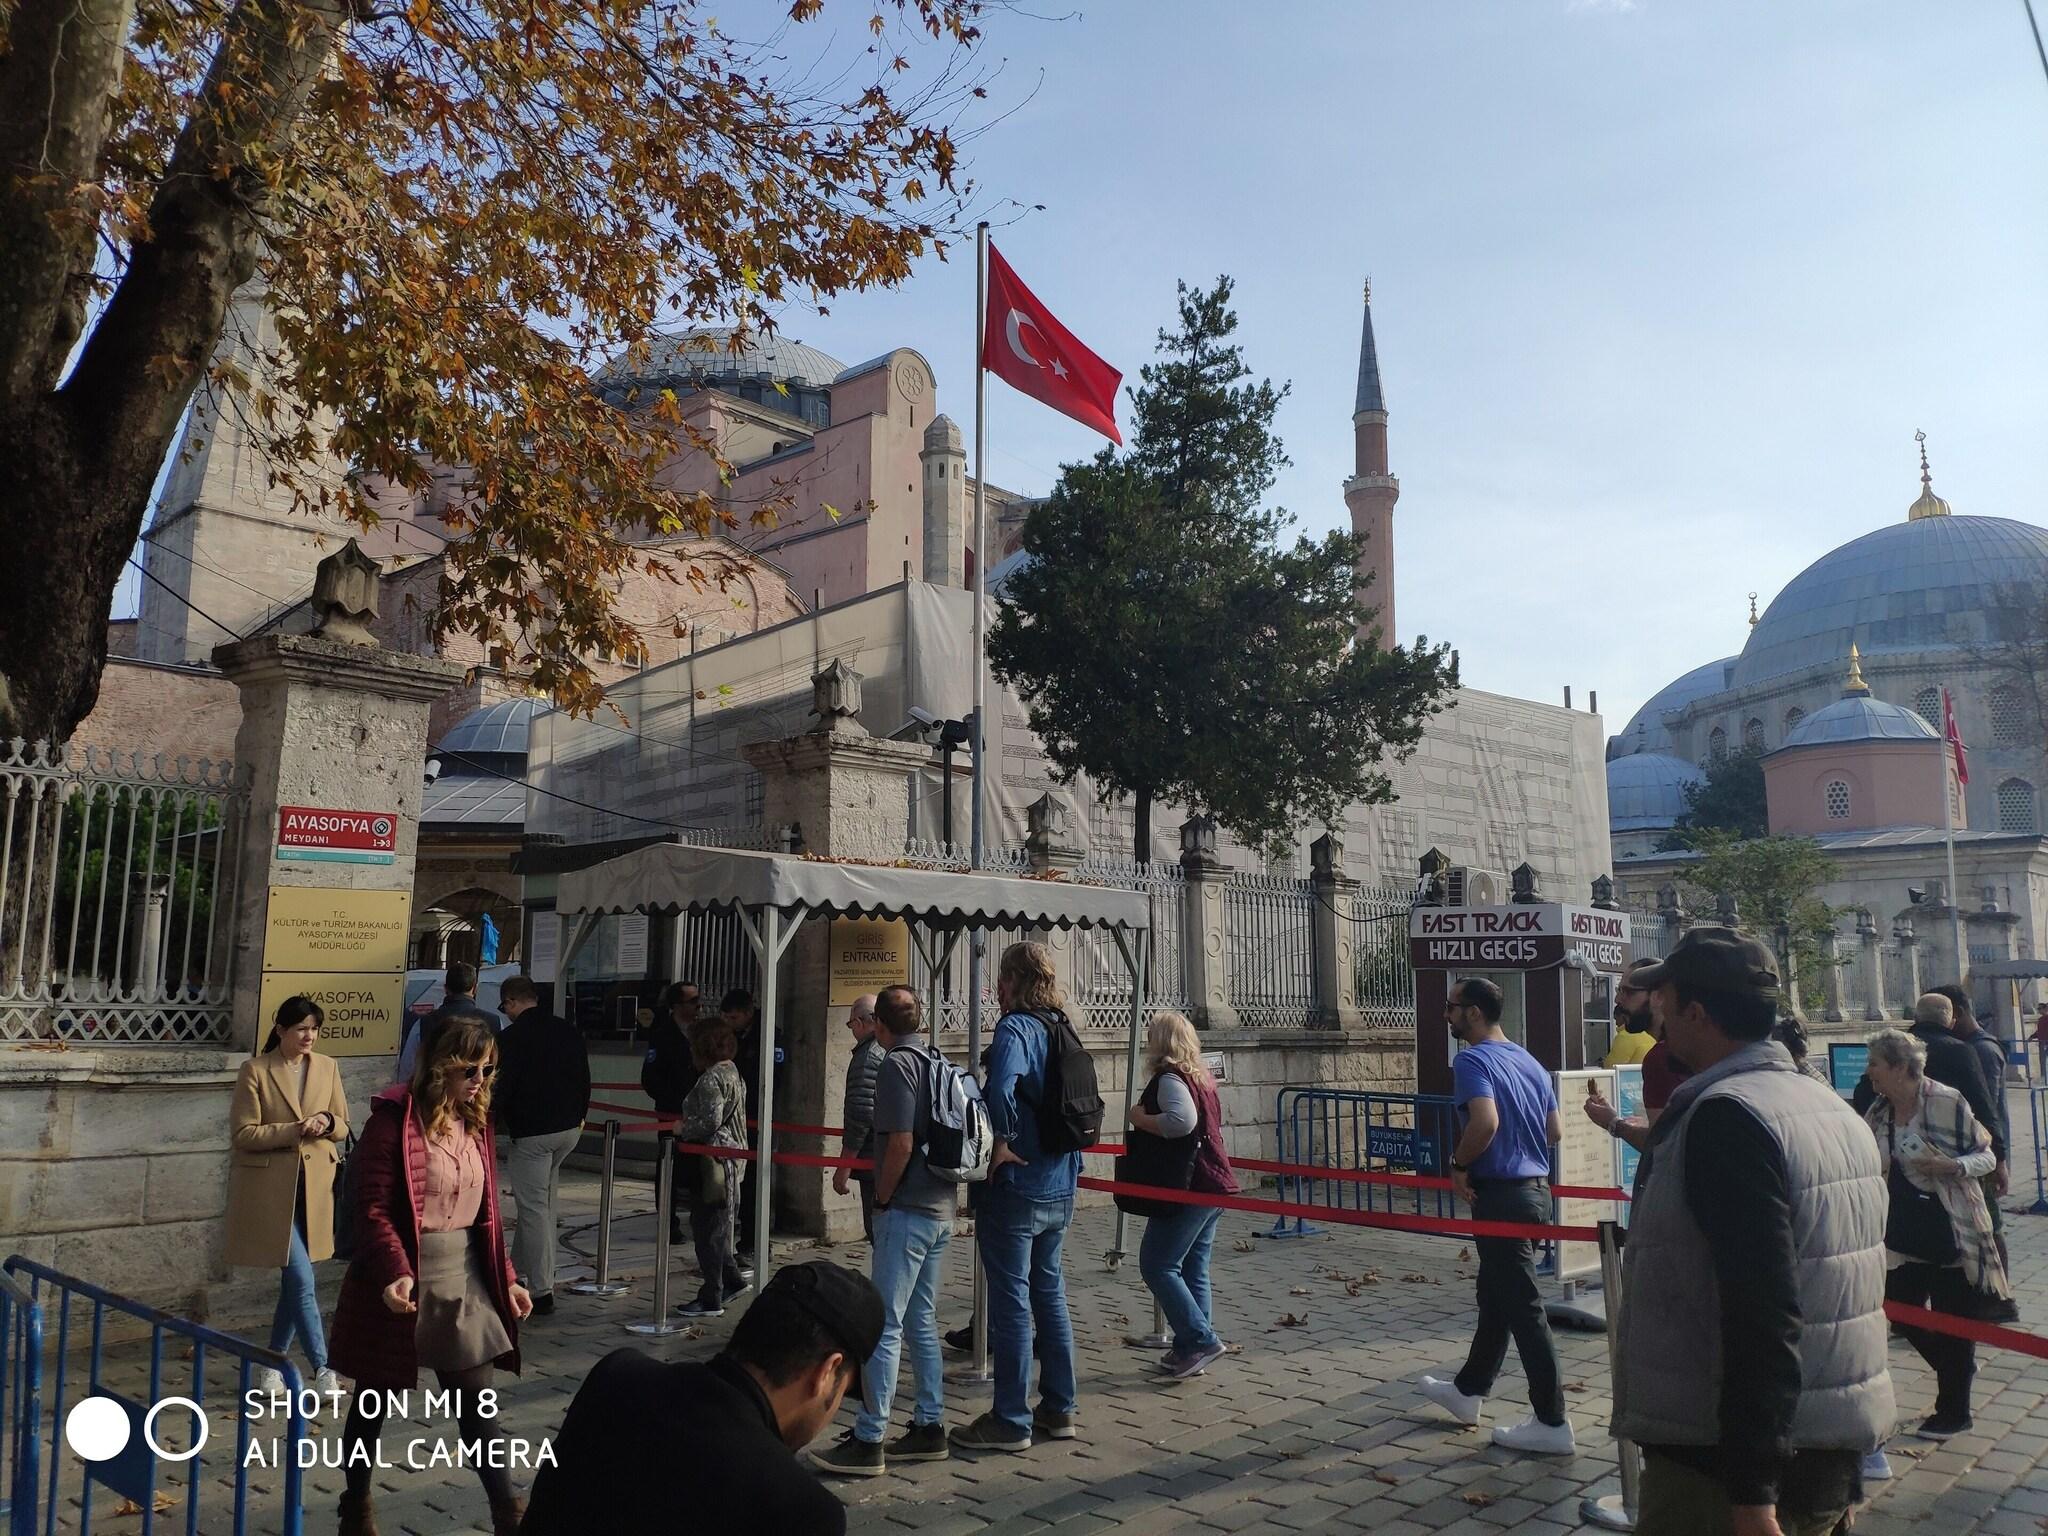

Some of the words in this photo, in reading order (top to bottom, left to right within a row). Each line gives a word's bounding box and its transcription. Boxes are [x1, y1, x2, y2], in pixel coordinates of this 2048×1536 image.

[286, 814, 369, 834] AYASOFYA
[284, 833, 329, 844] MEYDANI
[385, 839, 391, 848] 3
[273, 919, 309, 927] KÜLTÜR
[323, 919, 356, 929] TURİZM
[358, 920, 403, 930] BAKANLIĞI
[1422, 913, 1467, 933] FAST
[1471, 911, 1543, 932] TRACK
[1571, 912, 1593, 934] FAST
[1594, 915, 1624, 938] TRACK
[297, 930, 343, 939] AYASOFYA
[345, 930, 378, 940] MÜZESİ
[308, 940, 366, 951] MÜDÜRLÜĞÜ
[1429, 940, 1475, 960] HIZLI
[1479, 936, 1538, 962] GEÇİŞ
[842, 951, 897, 963] ENTRANCE
[1575, 940, 1598, 962] HIZLI
[1599, 941, 1623, 967] GEÇİŞ
[329, 1008, 390, 1023] SOPHIA)
[317, 1026, 364, 1039] SEUM
[1371, 1141, 1412, 1157] ZABITA
